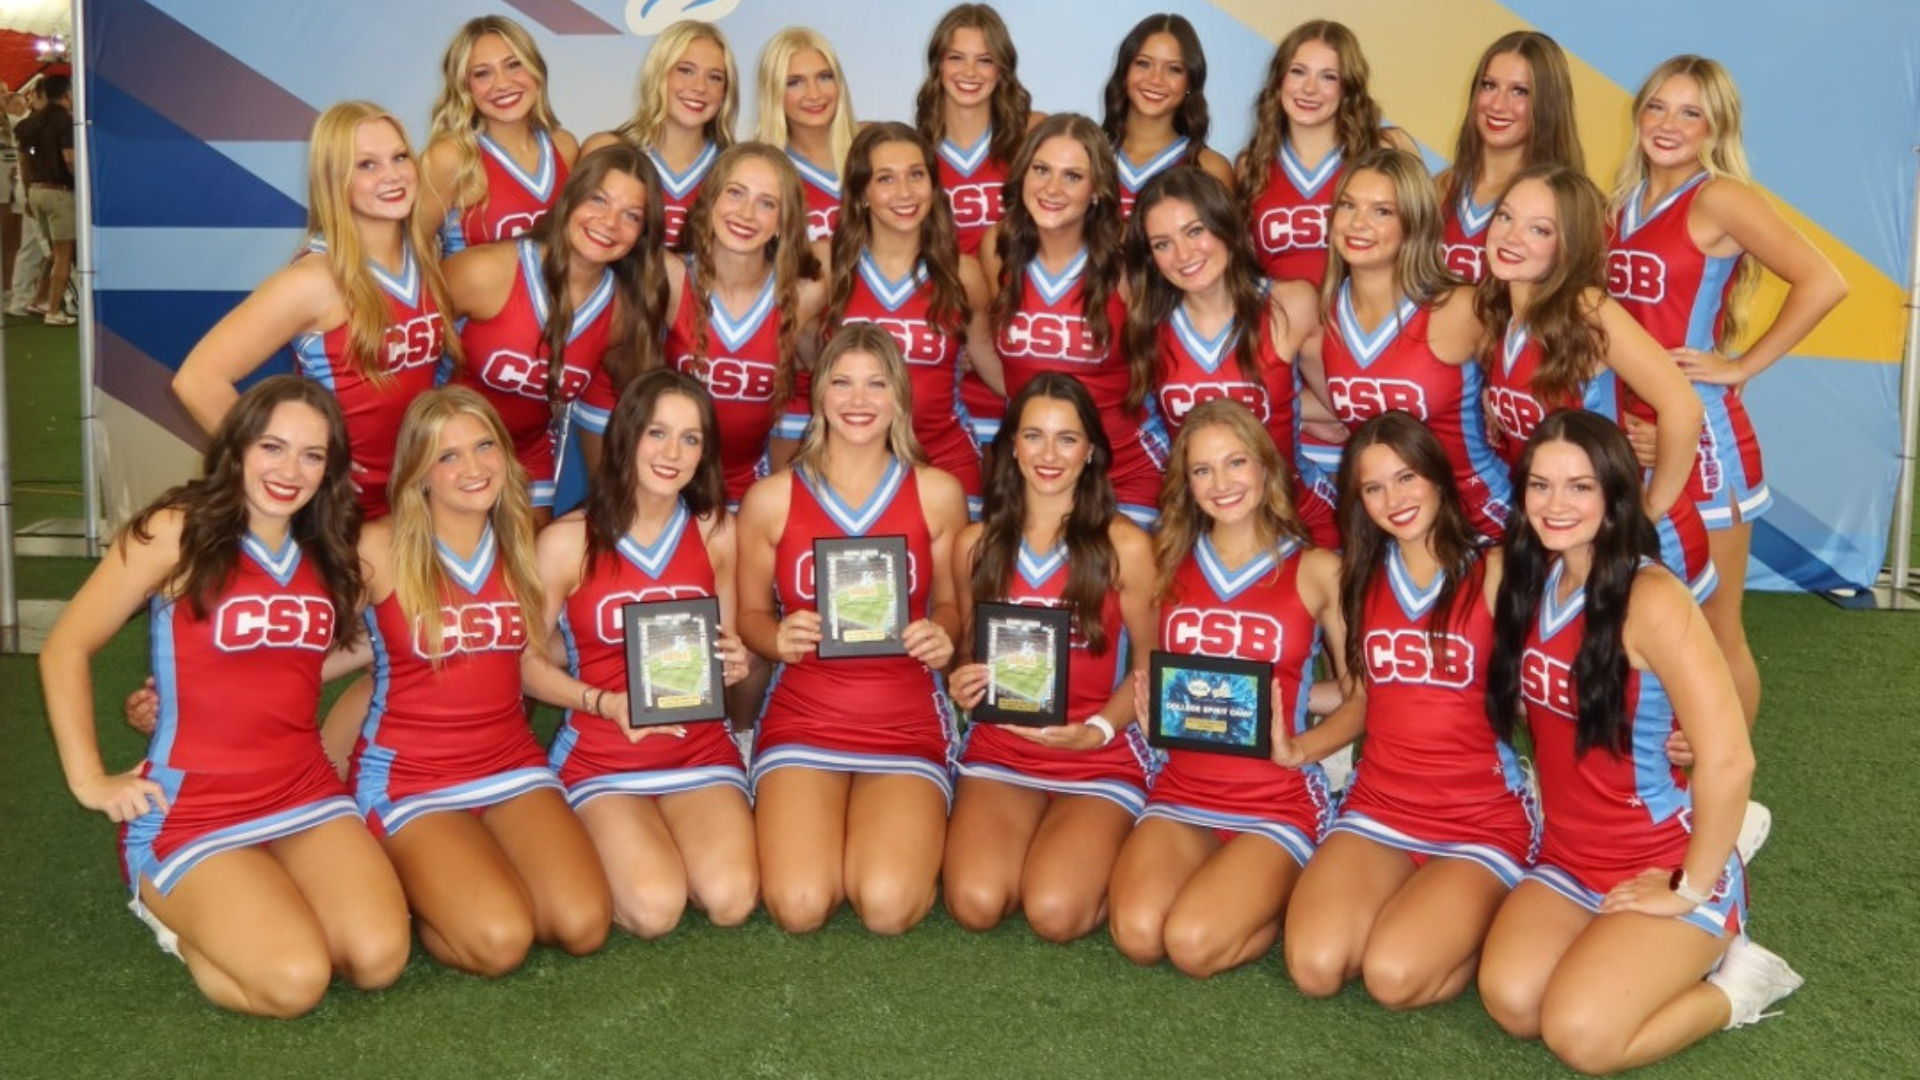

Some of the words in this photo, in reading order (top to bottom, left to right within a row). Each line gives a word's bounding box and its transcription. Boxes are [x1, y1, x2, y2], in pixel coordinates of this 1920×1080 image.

[944, 182, 1005, 229] SB
[1260, 205, 1333, 253] CS
[1607, 249, 1667, 304] SB
[215, 595, 336, 652] CSB
[414, 601, 528, 660] CSB
[1165, 608, 1283, 664] CSB
[1364, 629, 1475, 690] CSB
[1520, 647, 1579, 720] SB
